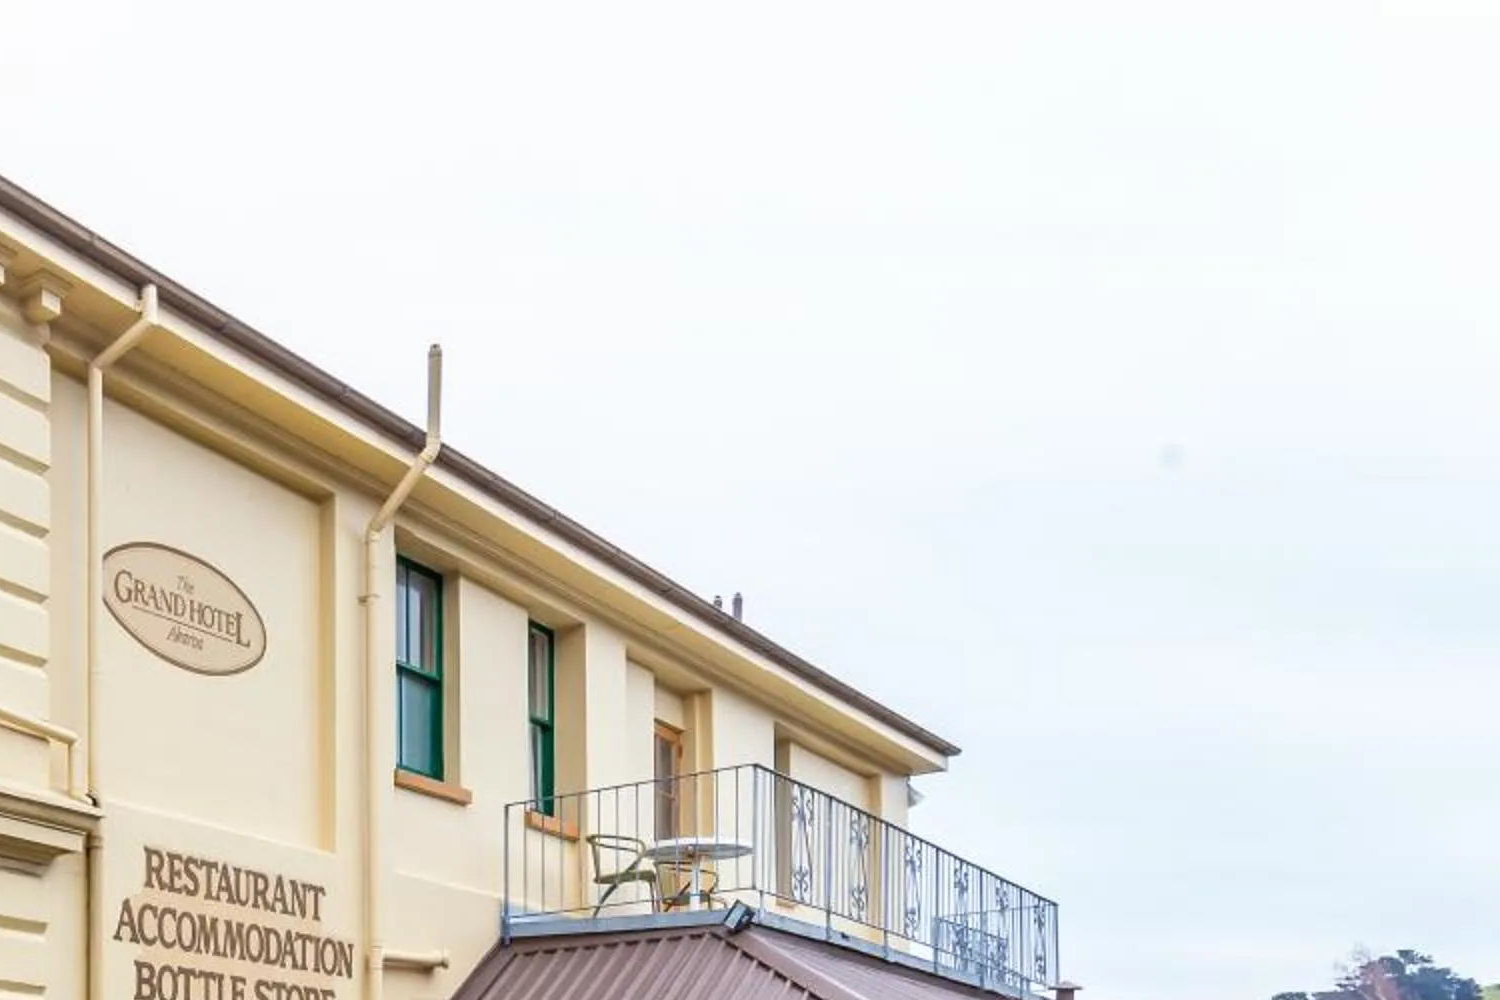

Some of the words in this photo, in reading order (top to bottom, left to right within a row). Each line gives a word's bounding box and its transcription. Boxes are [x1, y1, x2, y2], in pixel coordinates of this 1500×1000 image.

[113, 569, 186, 617] GRAND
[189, 598, 251, 648] HOTEL
[143, 845, 326, 922] RESTAURANT
[112, 897, 355, 980] ACCOMMODATION
